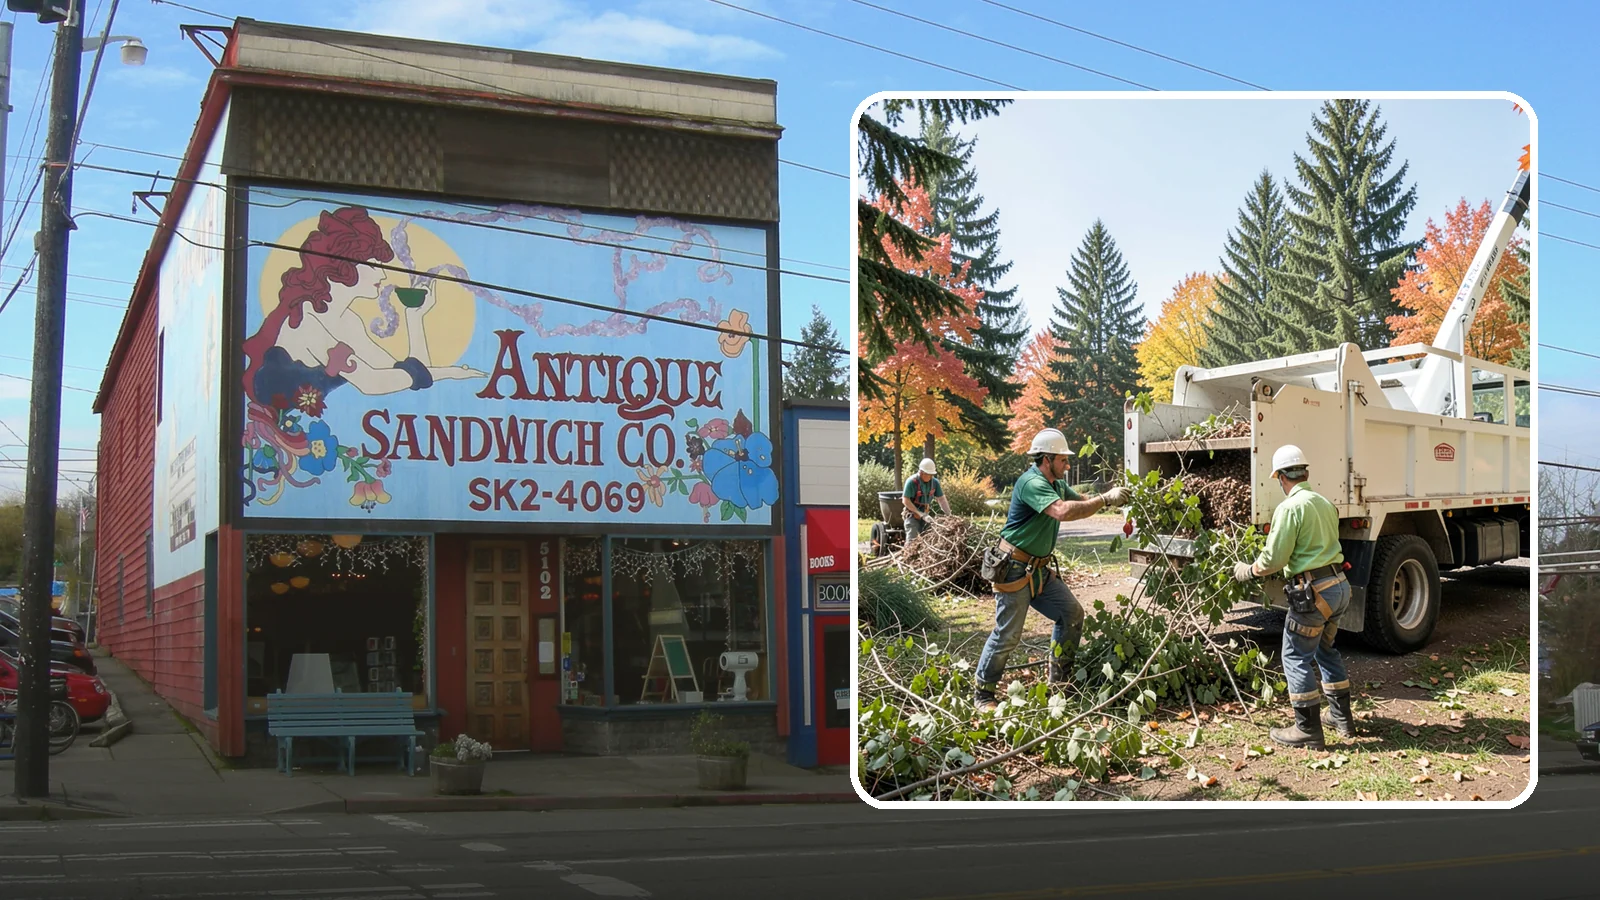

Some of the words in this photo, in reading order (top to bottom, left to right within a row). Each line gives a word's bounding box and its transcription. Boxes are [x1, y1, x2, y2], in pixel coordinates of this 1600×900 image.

[476, 329, 723, 420] ANTIQUE
[361, 408, 604, 467] SANDWICH
[617, 421, 685, 469] CO.
[468, 477, 645, 513] SK2-4069
[540, 541, 551, 600] 5102
[809, 555, 835, 569] BOOKS
